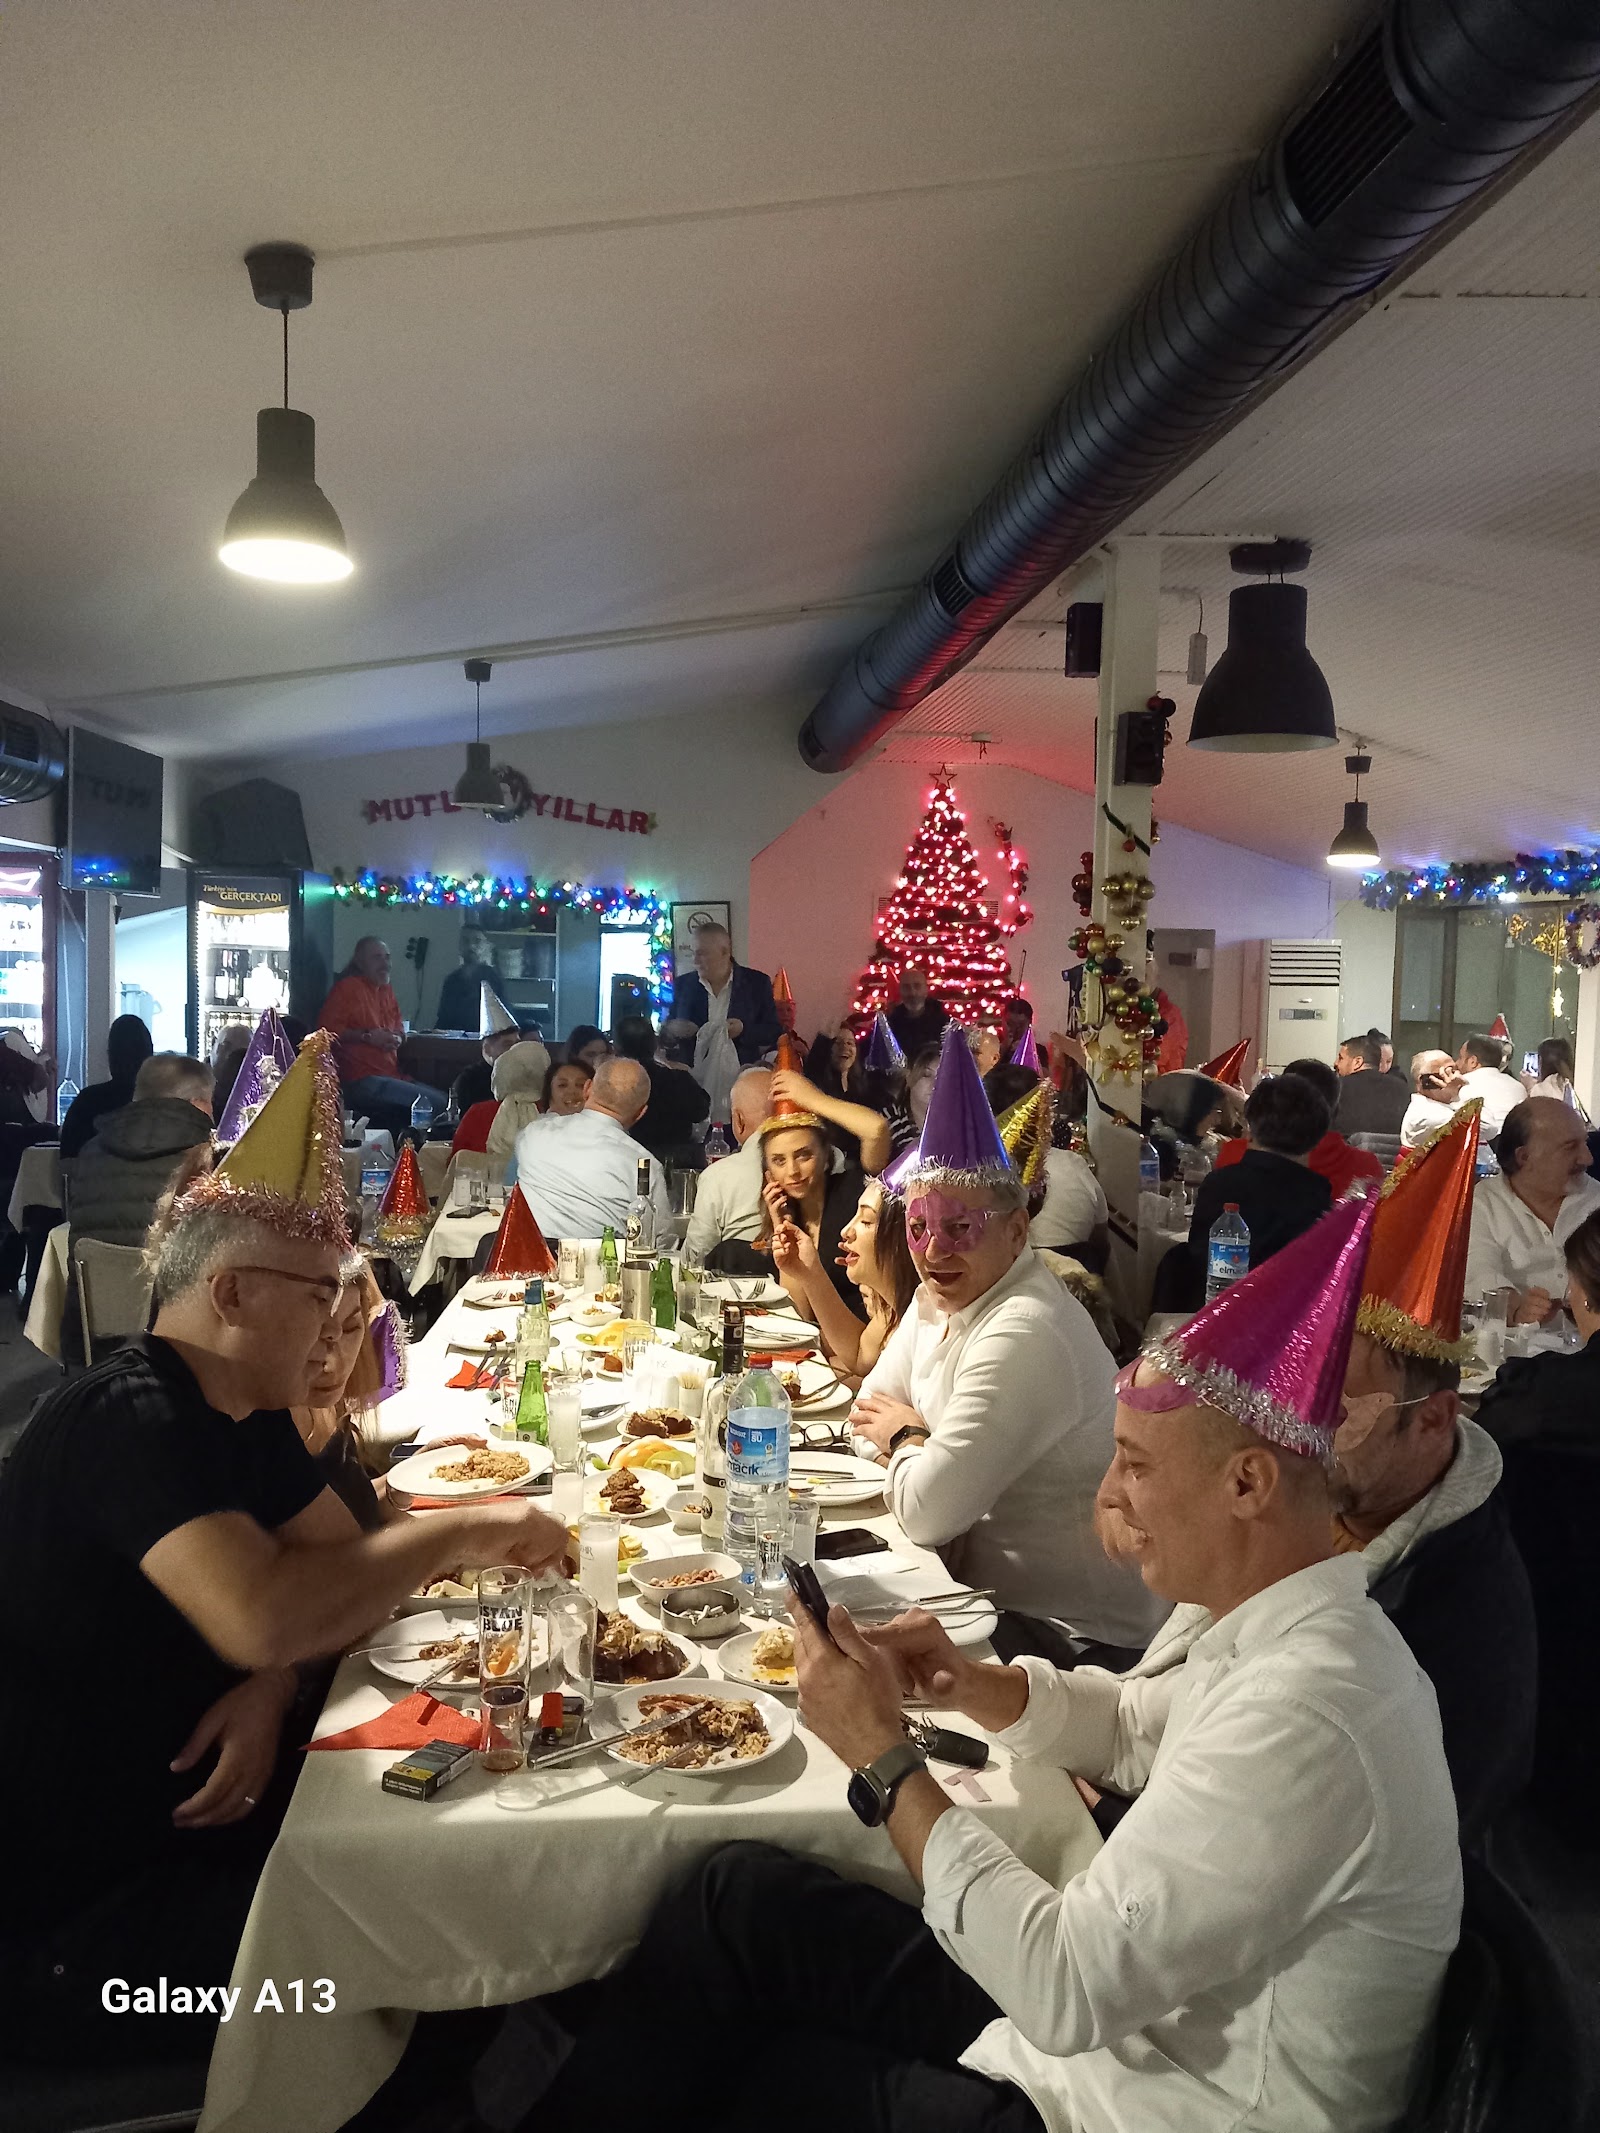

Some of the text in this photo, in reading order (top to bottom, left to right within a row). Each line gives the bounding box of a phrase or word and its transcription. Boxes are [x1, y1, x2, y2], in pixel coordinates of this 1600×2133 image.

[367, 790, 649, 835] MUTL YILLAR
[220, 891, 282, 902] GERÇEK TADI
[483, 1617, 524, 1632] BLUE
